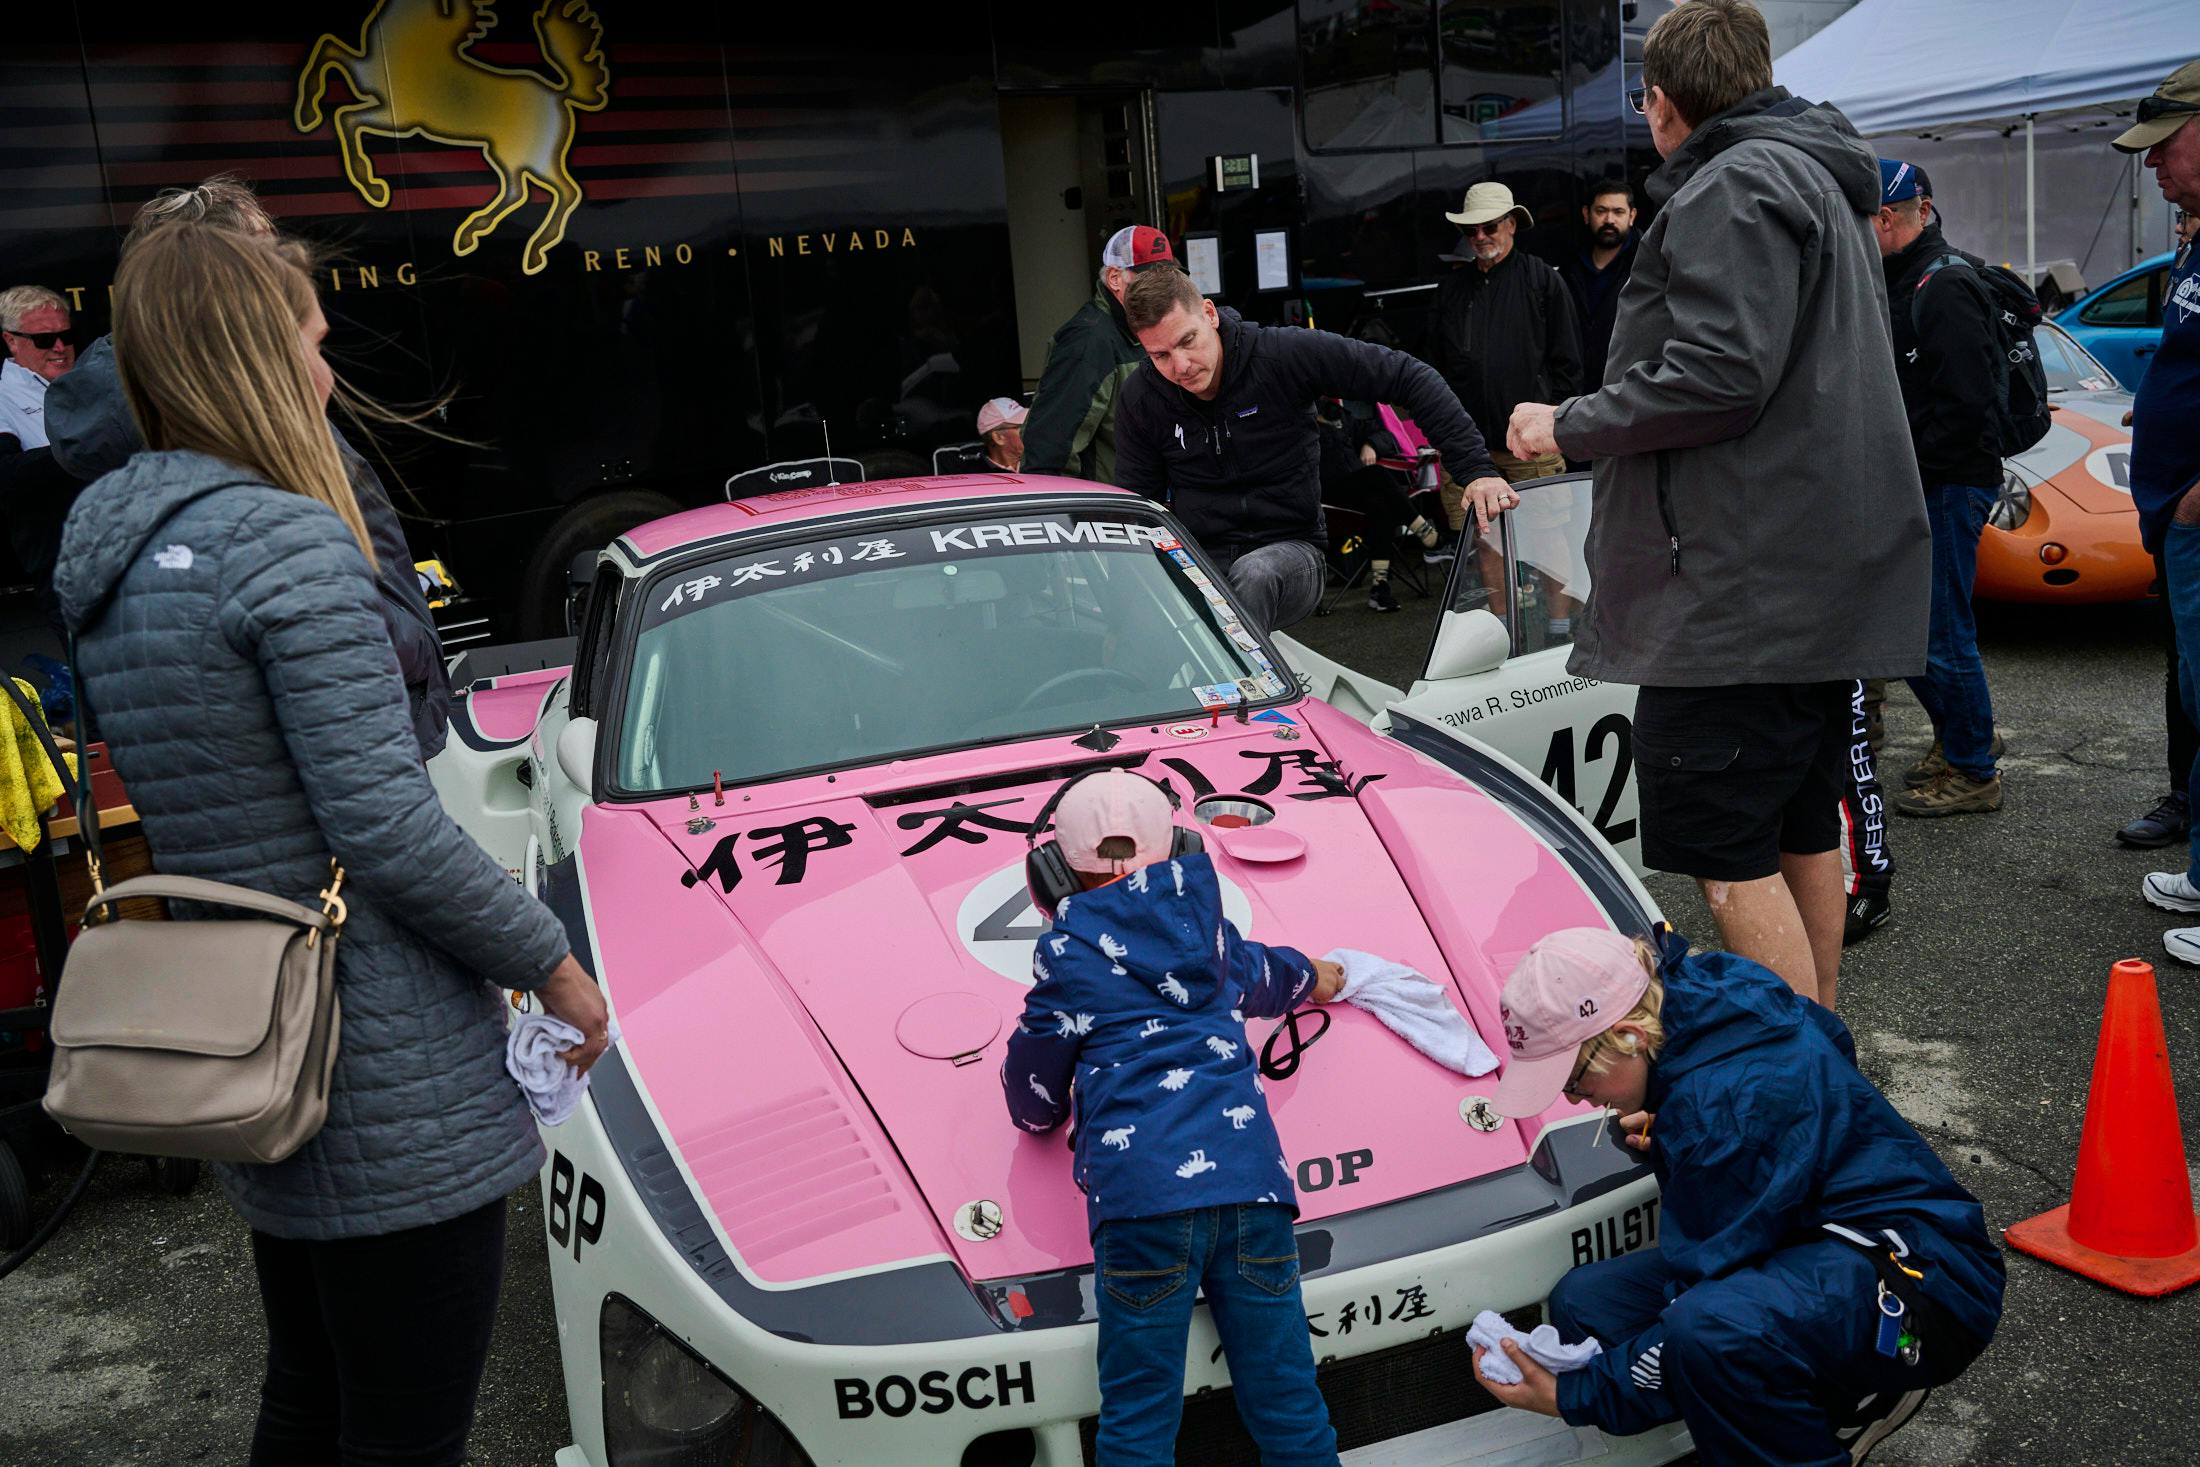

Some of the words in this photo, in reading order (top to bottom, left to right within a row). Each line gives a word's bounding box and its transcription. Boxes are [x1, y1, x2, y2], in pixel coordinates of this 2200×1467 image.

[584, 243, 693, 271] RENO
[768, 228, 916, 257] NEVADA
[930, 520, 1160, 553] KREMER
[1437, 706, 1484, 727] awa
[1486, 696, 1508, 716] R.
[1540, 713, 1637, 846] 42
[1850, 740, 1889, 873] WEBSTER
[1579, 1000, 1598, 1018] 42
[549, 1148, 606, 1264] BP
[834, 1360, 1035, 1419] BOSCH
